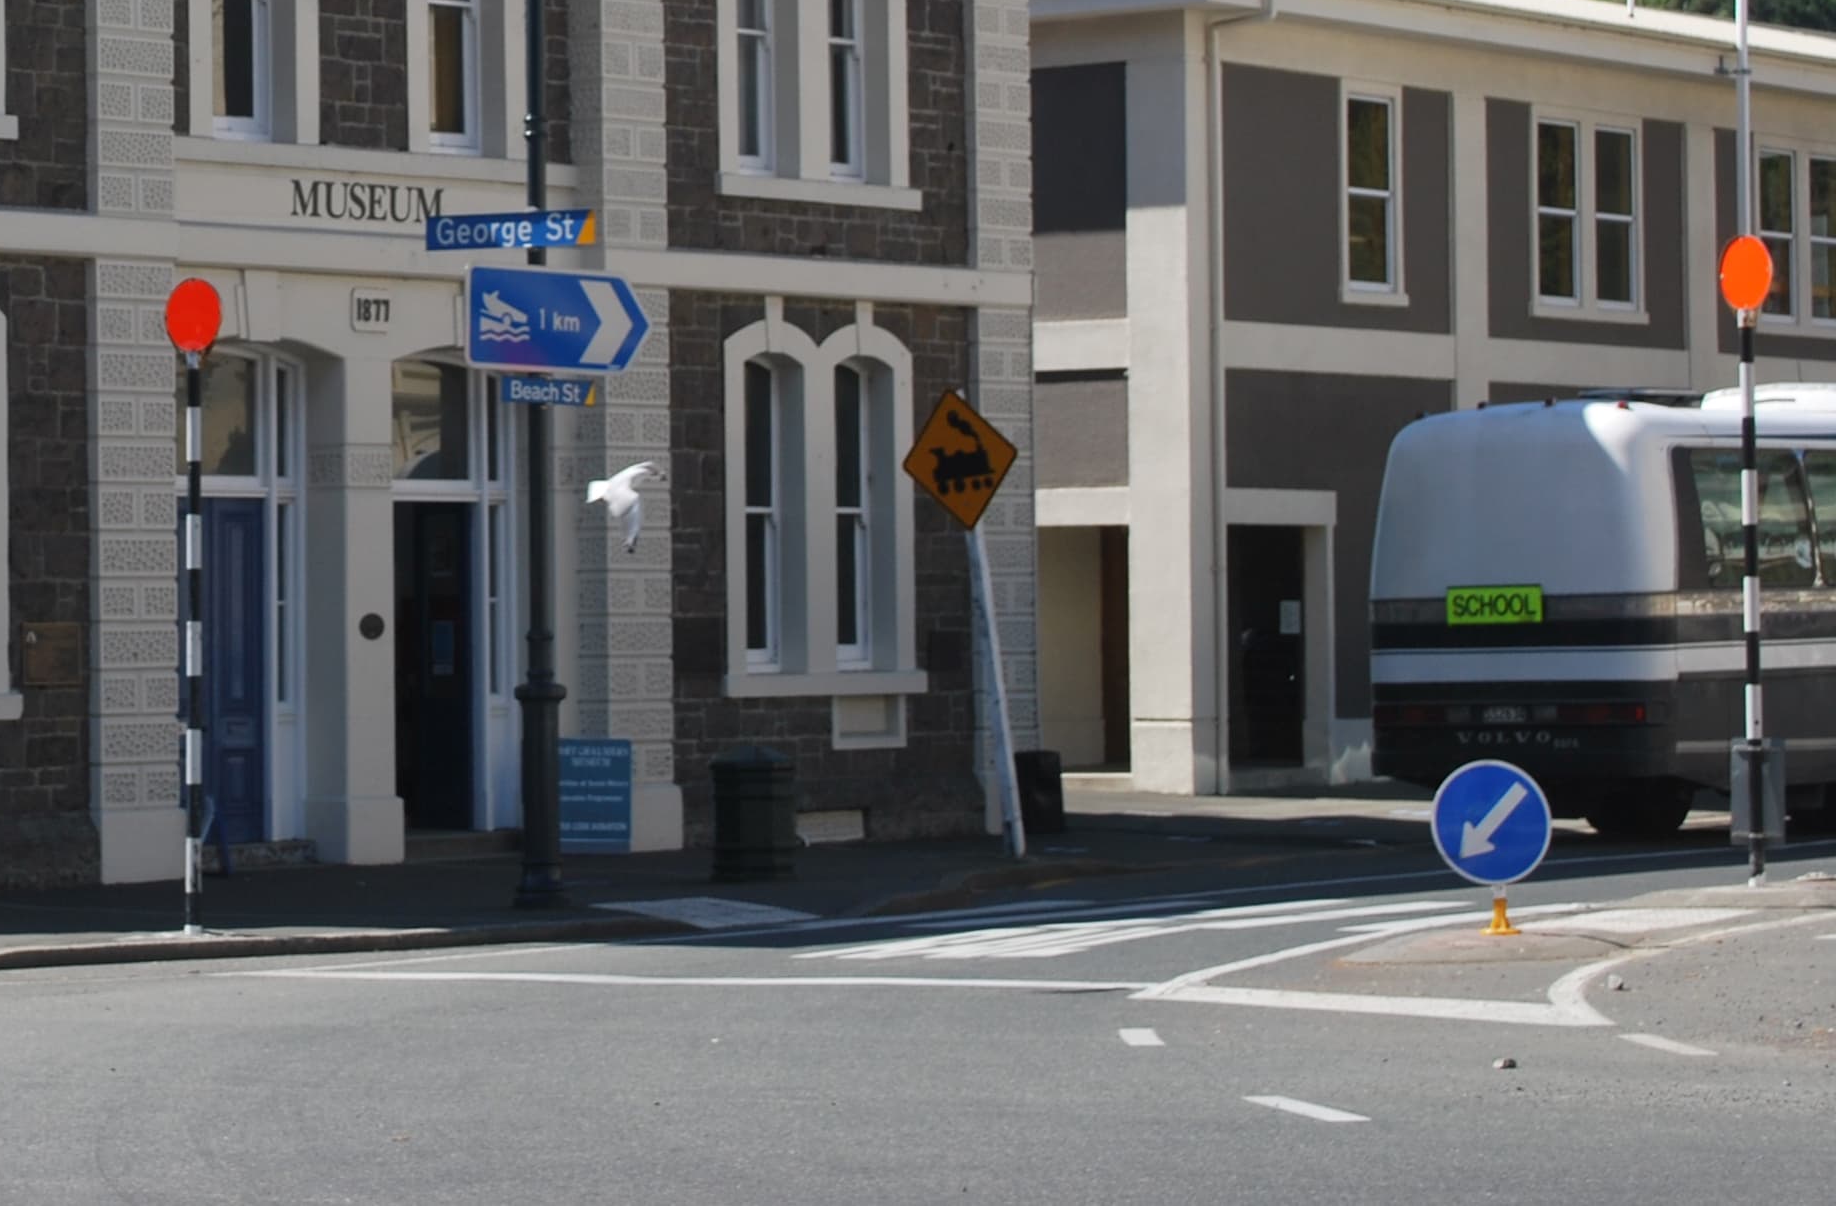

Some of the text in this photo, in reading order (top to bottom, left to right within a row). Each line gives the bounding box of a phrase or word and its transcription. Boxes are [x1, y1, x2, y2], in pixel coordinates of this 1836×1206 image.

[290, 179, 444, 224] MUSEUM
[435, 212, 575, 248] George St
[356, 298, 391, 323] 1877
[539, 308, 581, 333] 1 km
[510, 380, 581, 403] Beach St
[1452, 594, 1537, 617] SCHOOL
[1457, 730, 1552, 744] VOLVO
